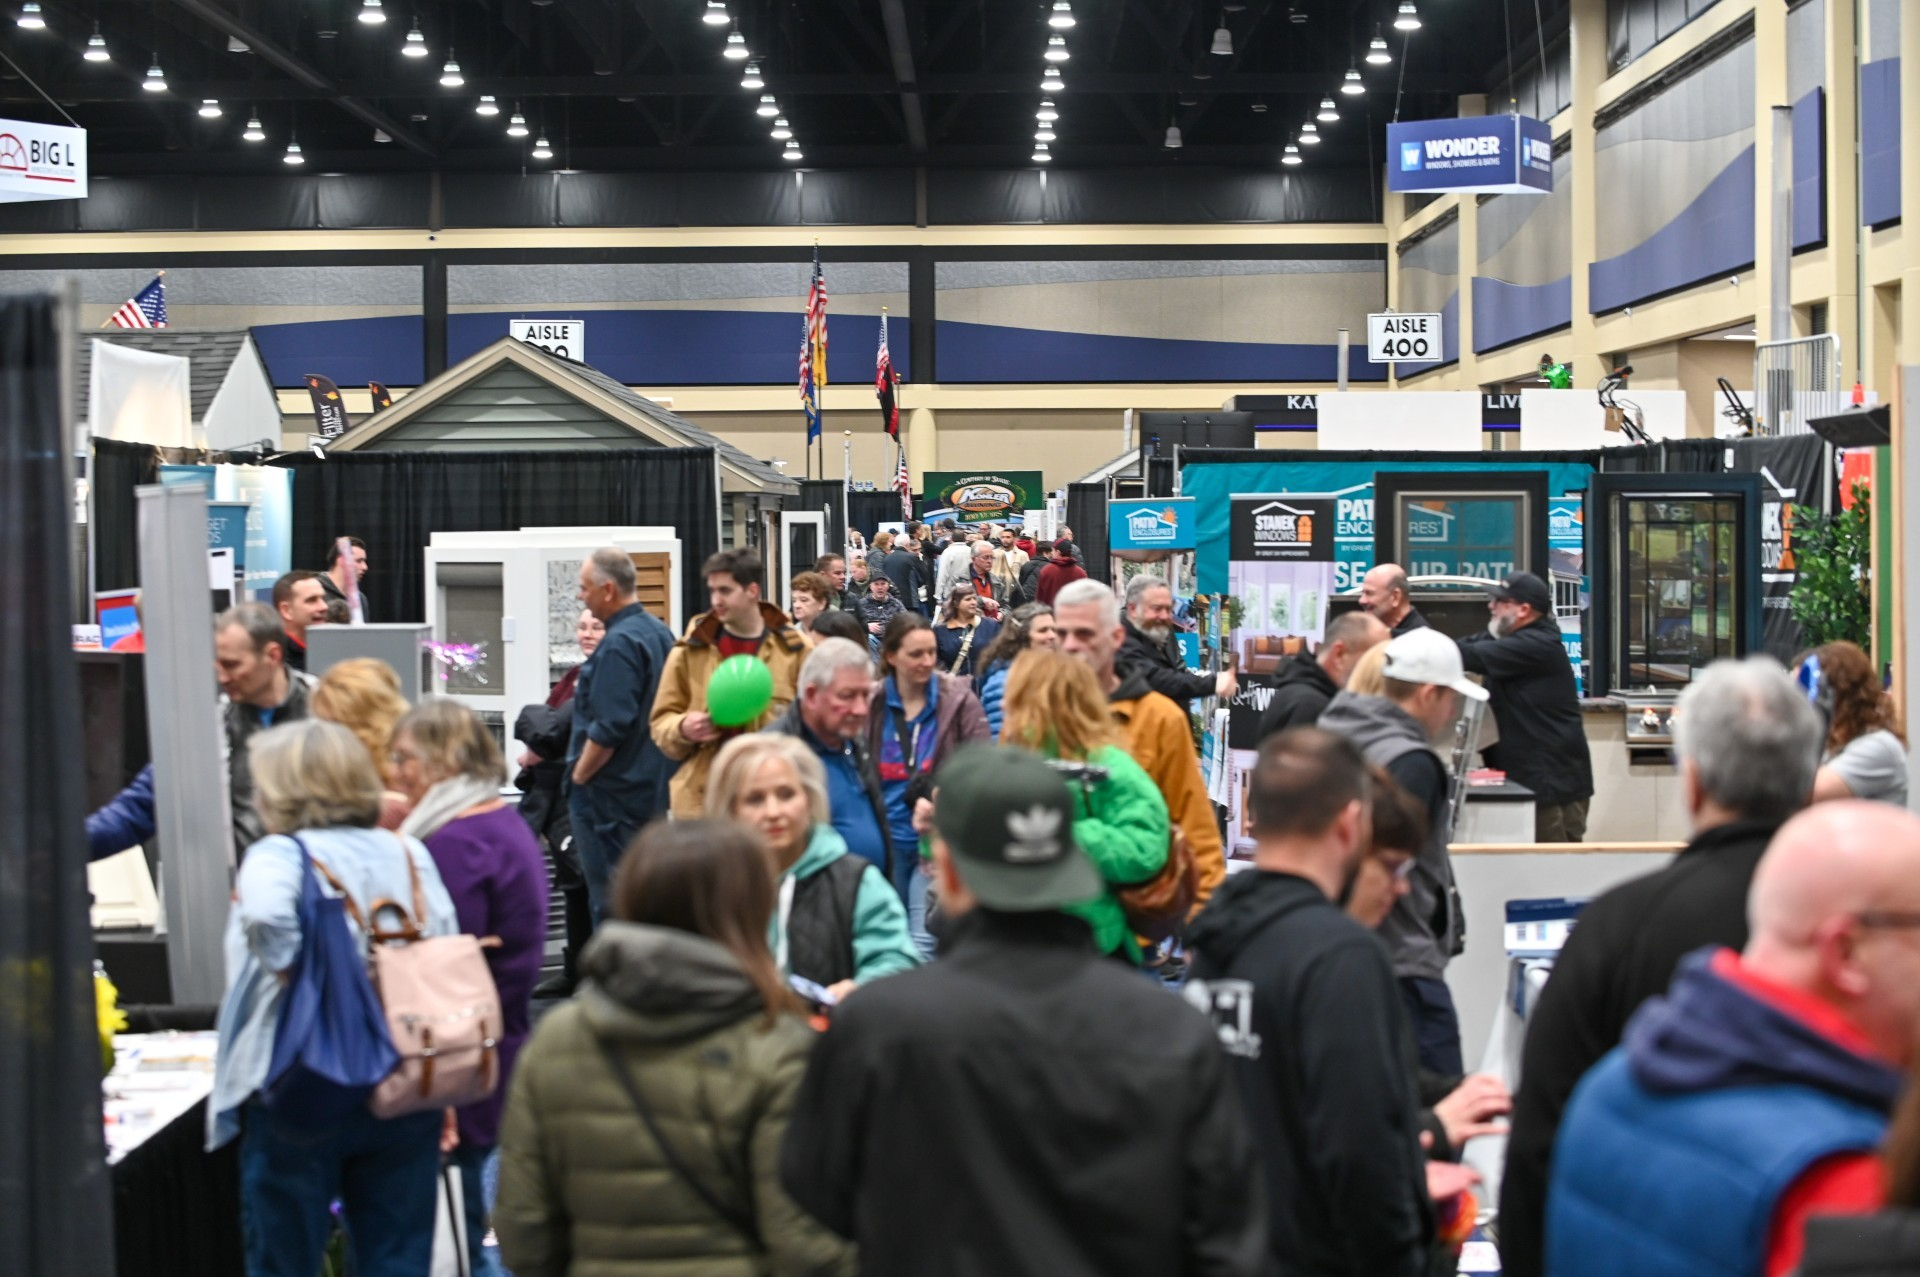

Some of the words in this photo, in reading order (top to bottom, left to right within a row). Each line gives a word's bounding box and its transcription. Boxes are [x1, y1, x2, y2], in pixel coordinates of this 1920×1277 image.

[31, 139, 60, 165] BIG
[66, 143, 76, 167] L
[1425, 136, 1500, 159] WONDER
[1404, 149, 1420, 165] W
[526, 325, 569, 339] AISLE
[1383, 318, 1427, 333] AISLE
[1382, 338, 1428, 357] 400
[958, 487, 1011, 505] KOHLER
[1132, 517, 1158, 529] PATIO
[1255, 515, 1297, 531] STANEK
[1254, 530, 1297, 541] WINDOWS
